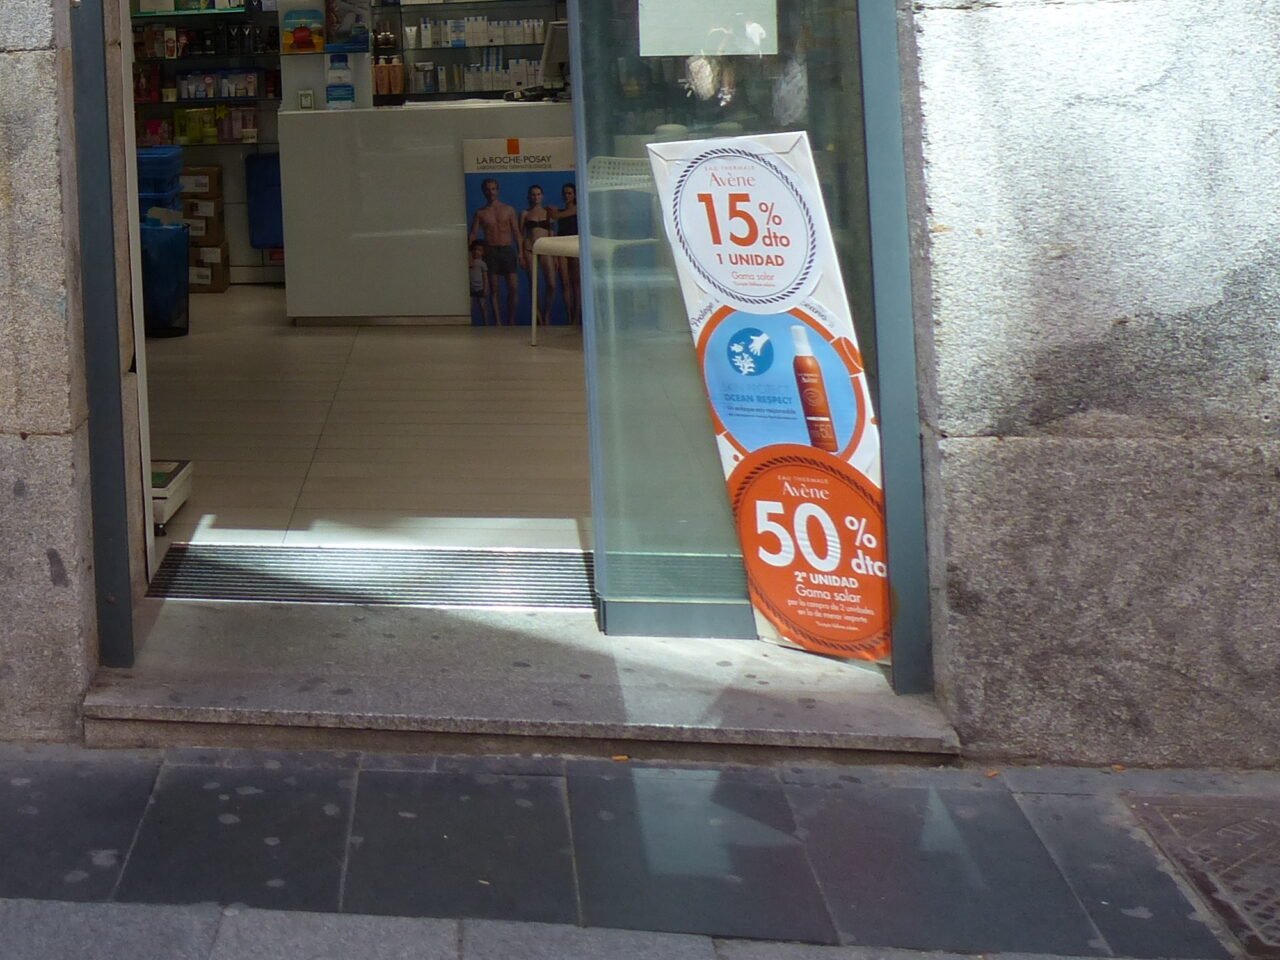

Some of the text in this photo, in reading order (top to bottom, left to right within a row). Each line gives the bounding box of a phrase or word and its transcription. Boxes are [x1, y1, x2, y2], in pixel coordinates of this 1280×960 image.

[476, 154, 552, 165] LA ROCHE-POSAY
[709, 171, 756, 188] Avène
[762, 228, 791, 248] dto
[716, 253, 785, 267] 1 UNIDAD
[731, 271, 775, 281] Gama solar
[724, 393, 793, 404] OCEAN RESPECT
[782, 481, 830, 500] Avène
[850, 549, 888, 578] dto
[809, 573, 859, 589] UNIDAD
[795, 584, 862, 603] Gama solar
